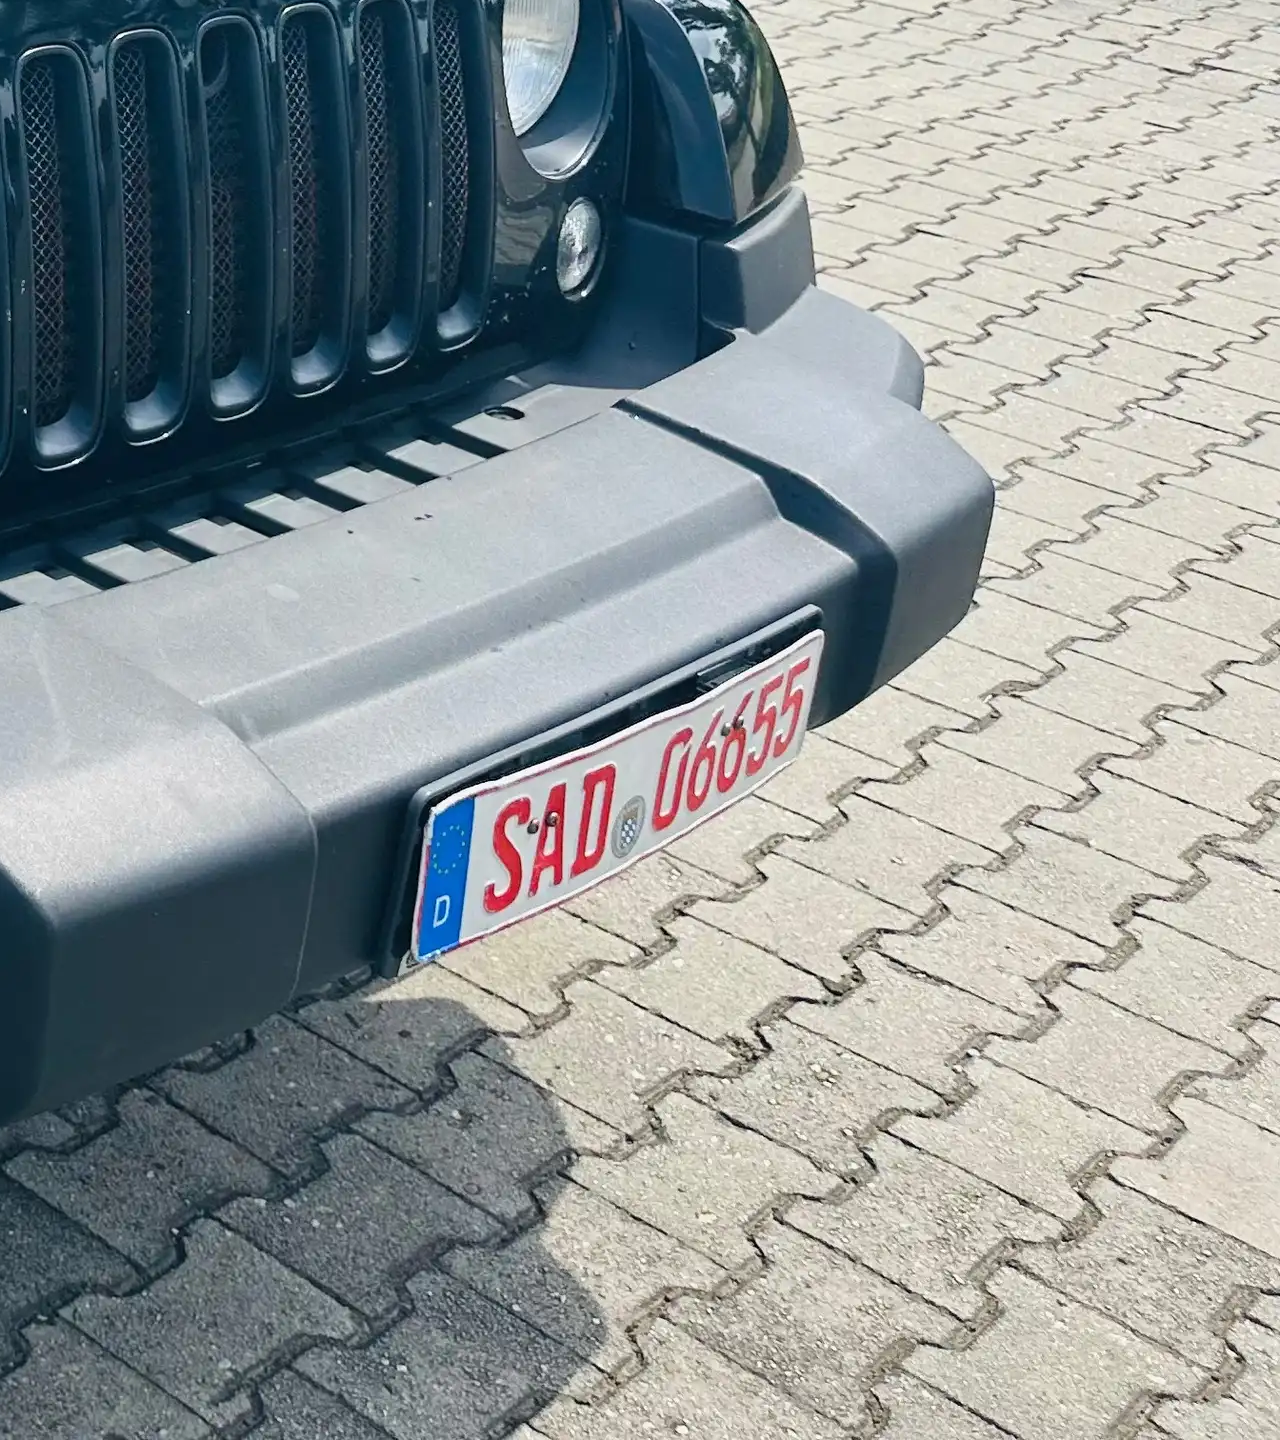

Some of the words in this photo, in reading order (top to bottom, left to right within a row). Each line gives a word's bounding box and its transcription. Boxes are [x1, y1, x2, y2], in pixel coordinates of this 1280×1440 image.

[482, 763, 617, 914] SAD
[651, 655, 811, 832] 06655
[432, 894, 450, 929] D
